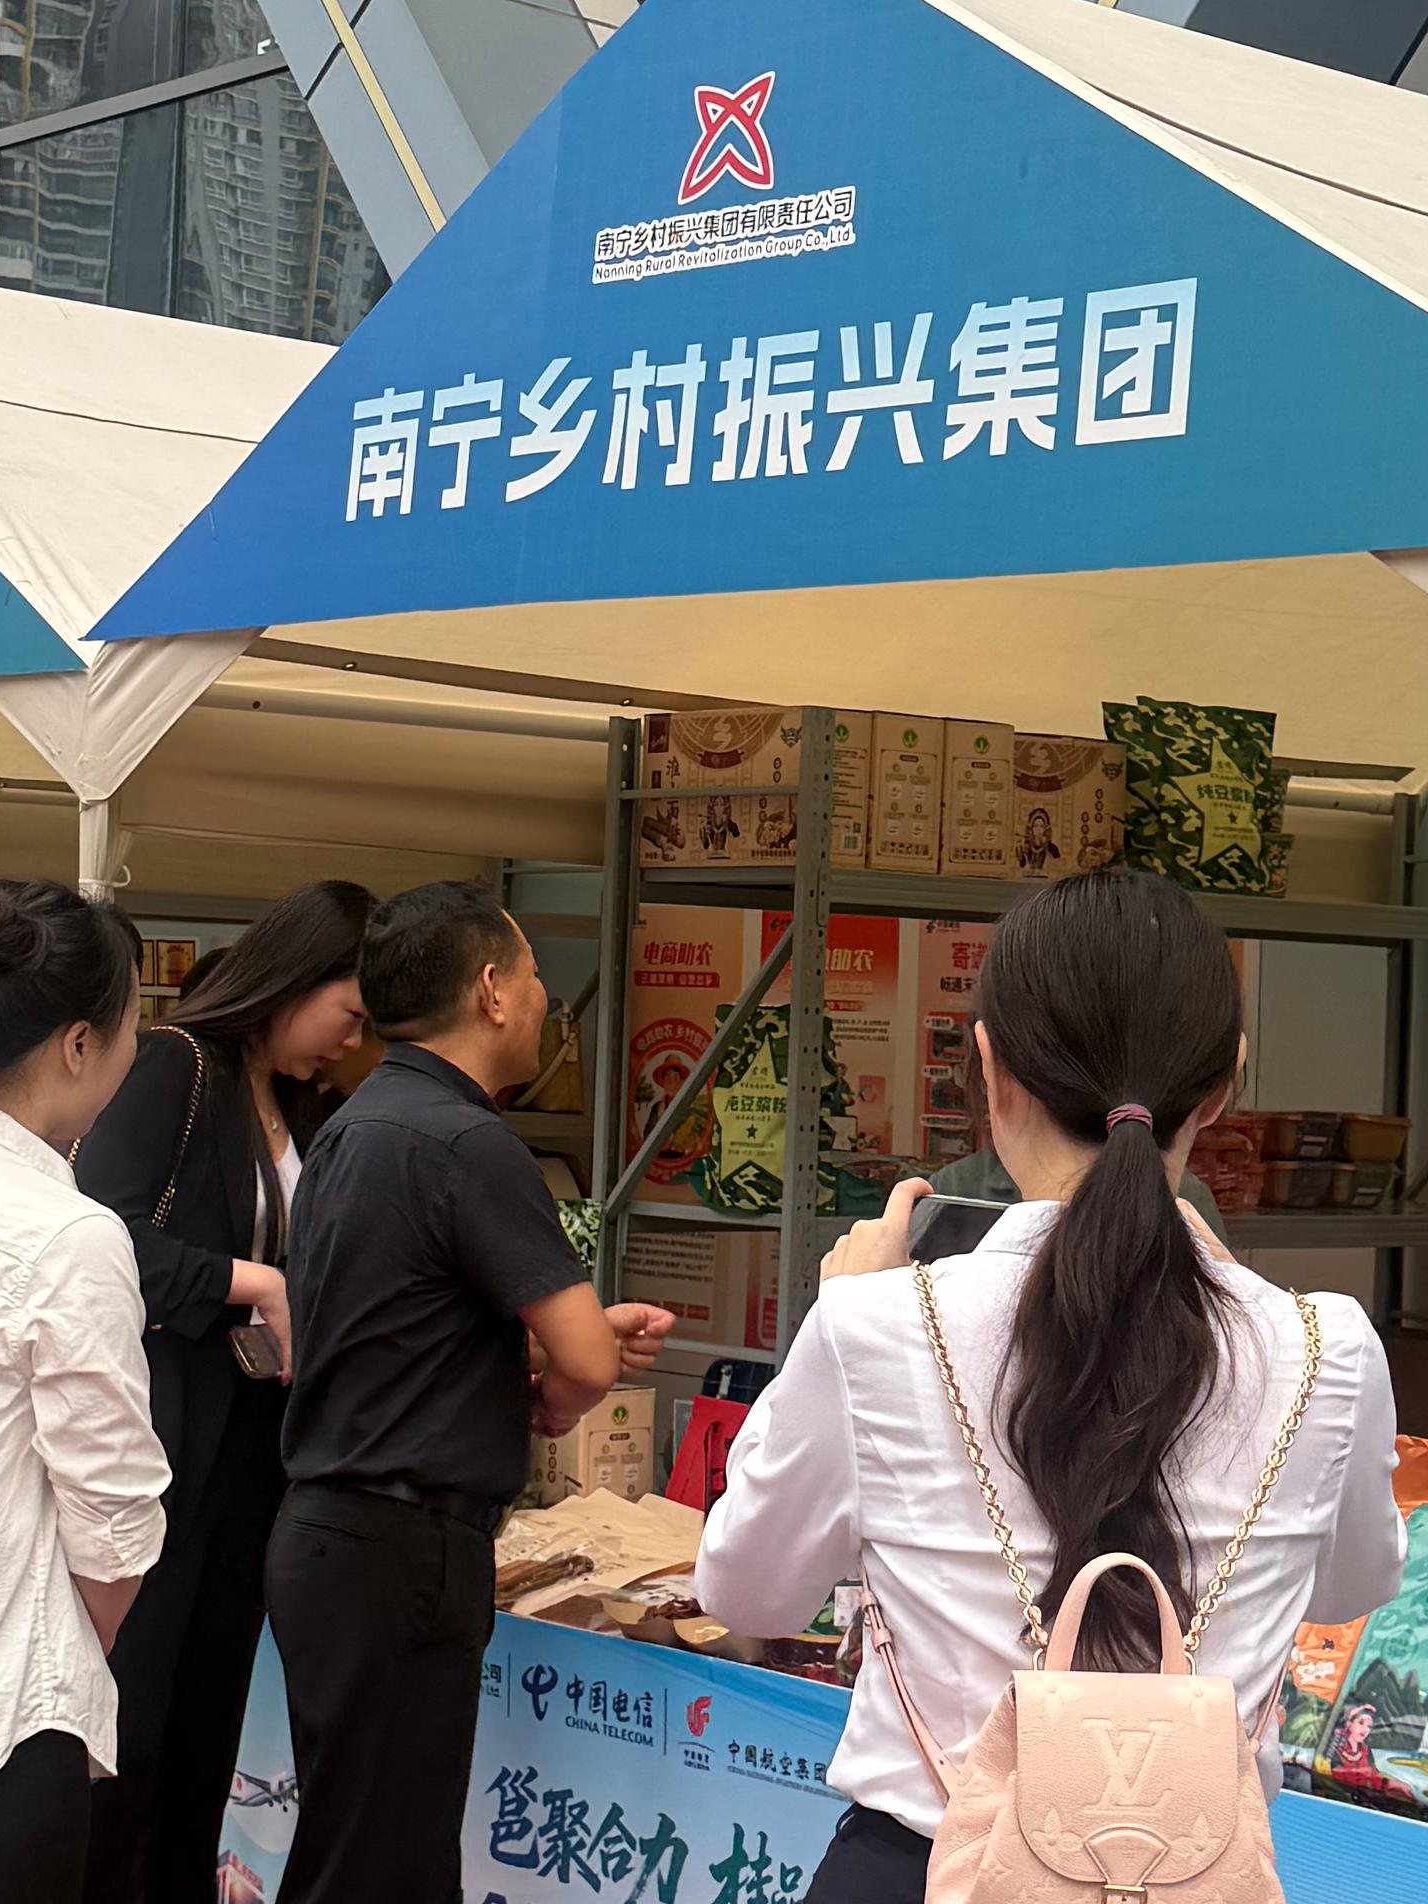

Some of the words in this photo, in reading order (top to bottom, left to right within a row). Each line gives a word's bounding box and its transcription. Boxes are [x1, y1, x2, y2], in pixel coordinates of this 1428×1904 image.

[597, 190, 853, 259] 南宁乡村振兴集团有限责任公司
[595, 262, 643, 280] Nanning
[645, 254, 677, 272] Rural
[765, 235, 803, 256] Group
[345, 277, 1198, 522] 南宁乡村振兴集团
[825, 948, 874, 972] 助农
[565, 1674, 654, 1728] 中国电信
[565, 1714, 600, 1736] CHINA
[602, 1723, 654, 1749] TELECOM
